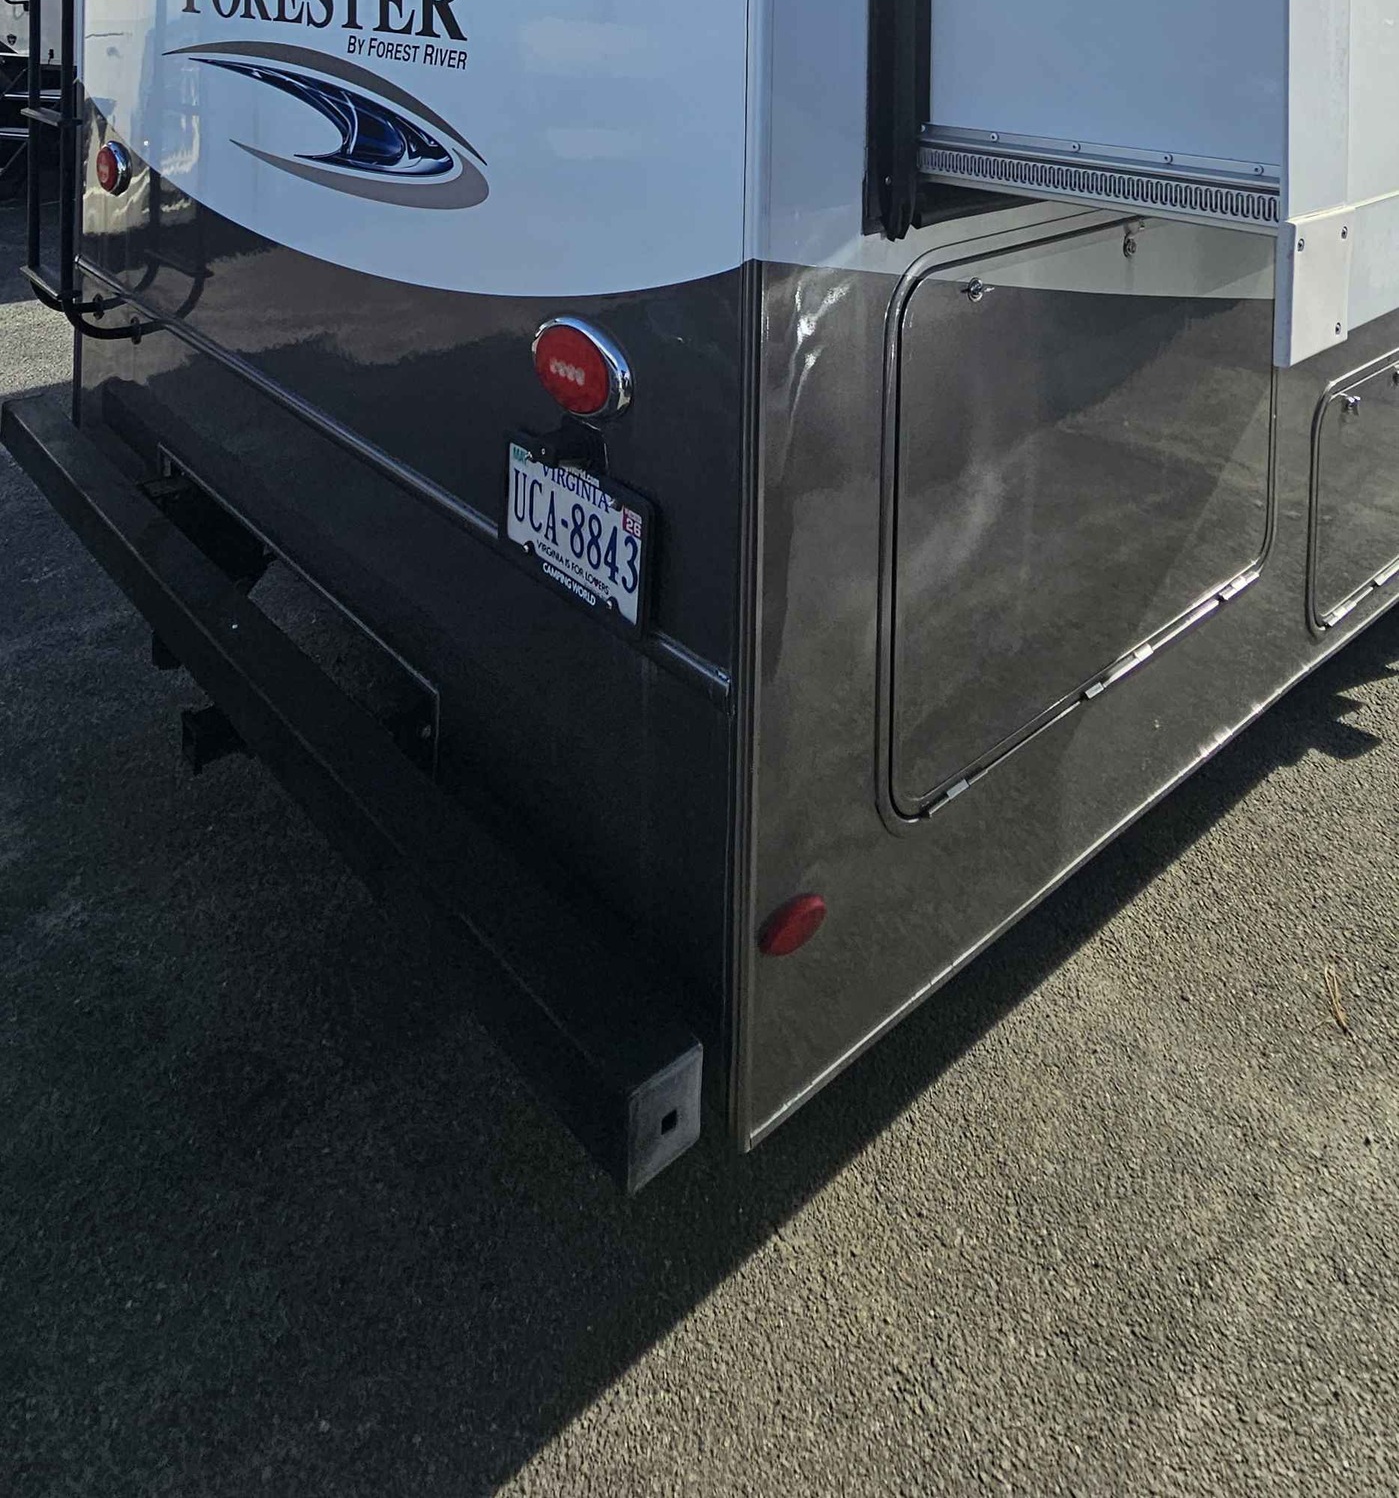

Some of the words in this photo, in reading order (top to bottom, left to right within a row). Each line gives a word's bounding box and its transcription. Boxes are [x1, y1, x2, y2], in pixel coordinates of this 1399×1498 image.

[367, 37, 420, 63] FOREST
[423, 43, 468, 70] RIVER
[542, 464, 610, 514] VIRGINIA
[513, 468, 639, 594] UCA-8843
[626, 517, 642, 538] 26
[537, 540, 564, 564] VIRGINIA
[565, 558, 570, 569] IS
[571, 561, 584, 578] FOR
[543, 563, 572, 589] CAMPING
[572, 580, 596, 605] WORLD
